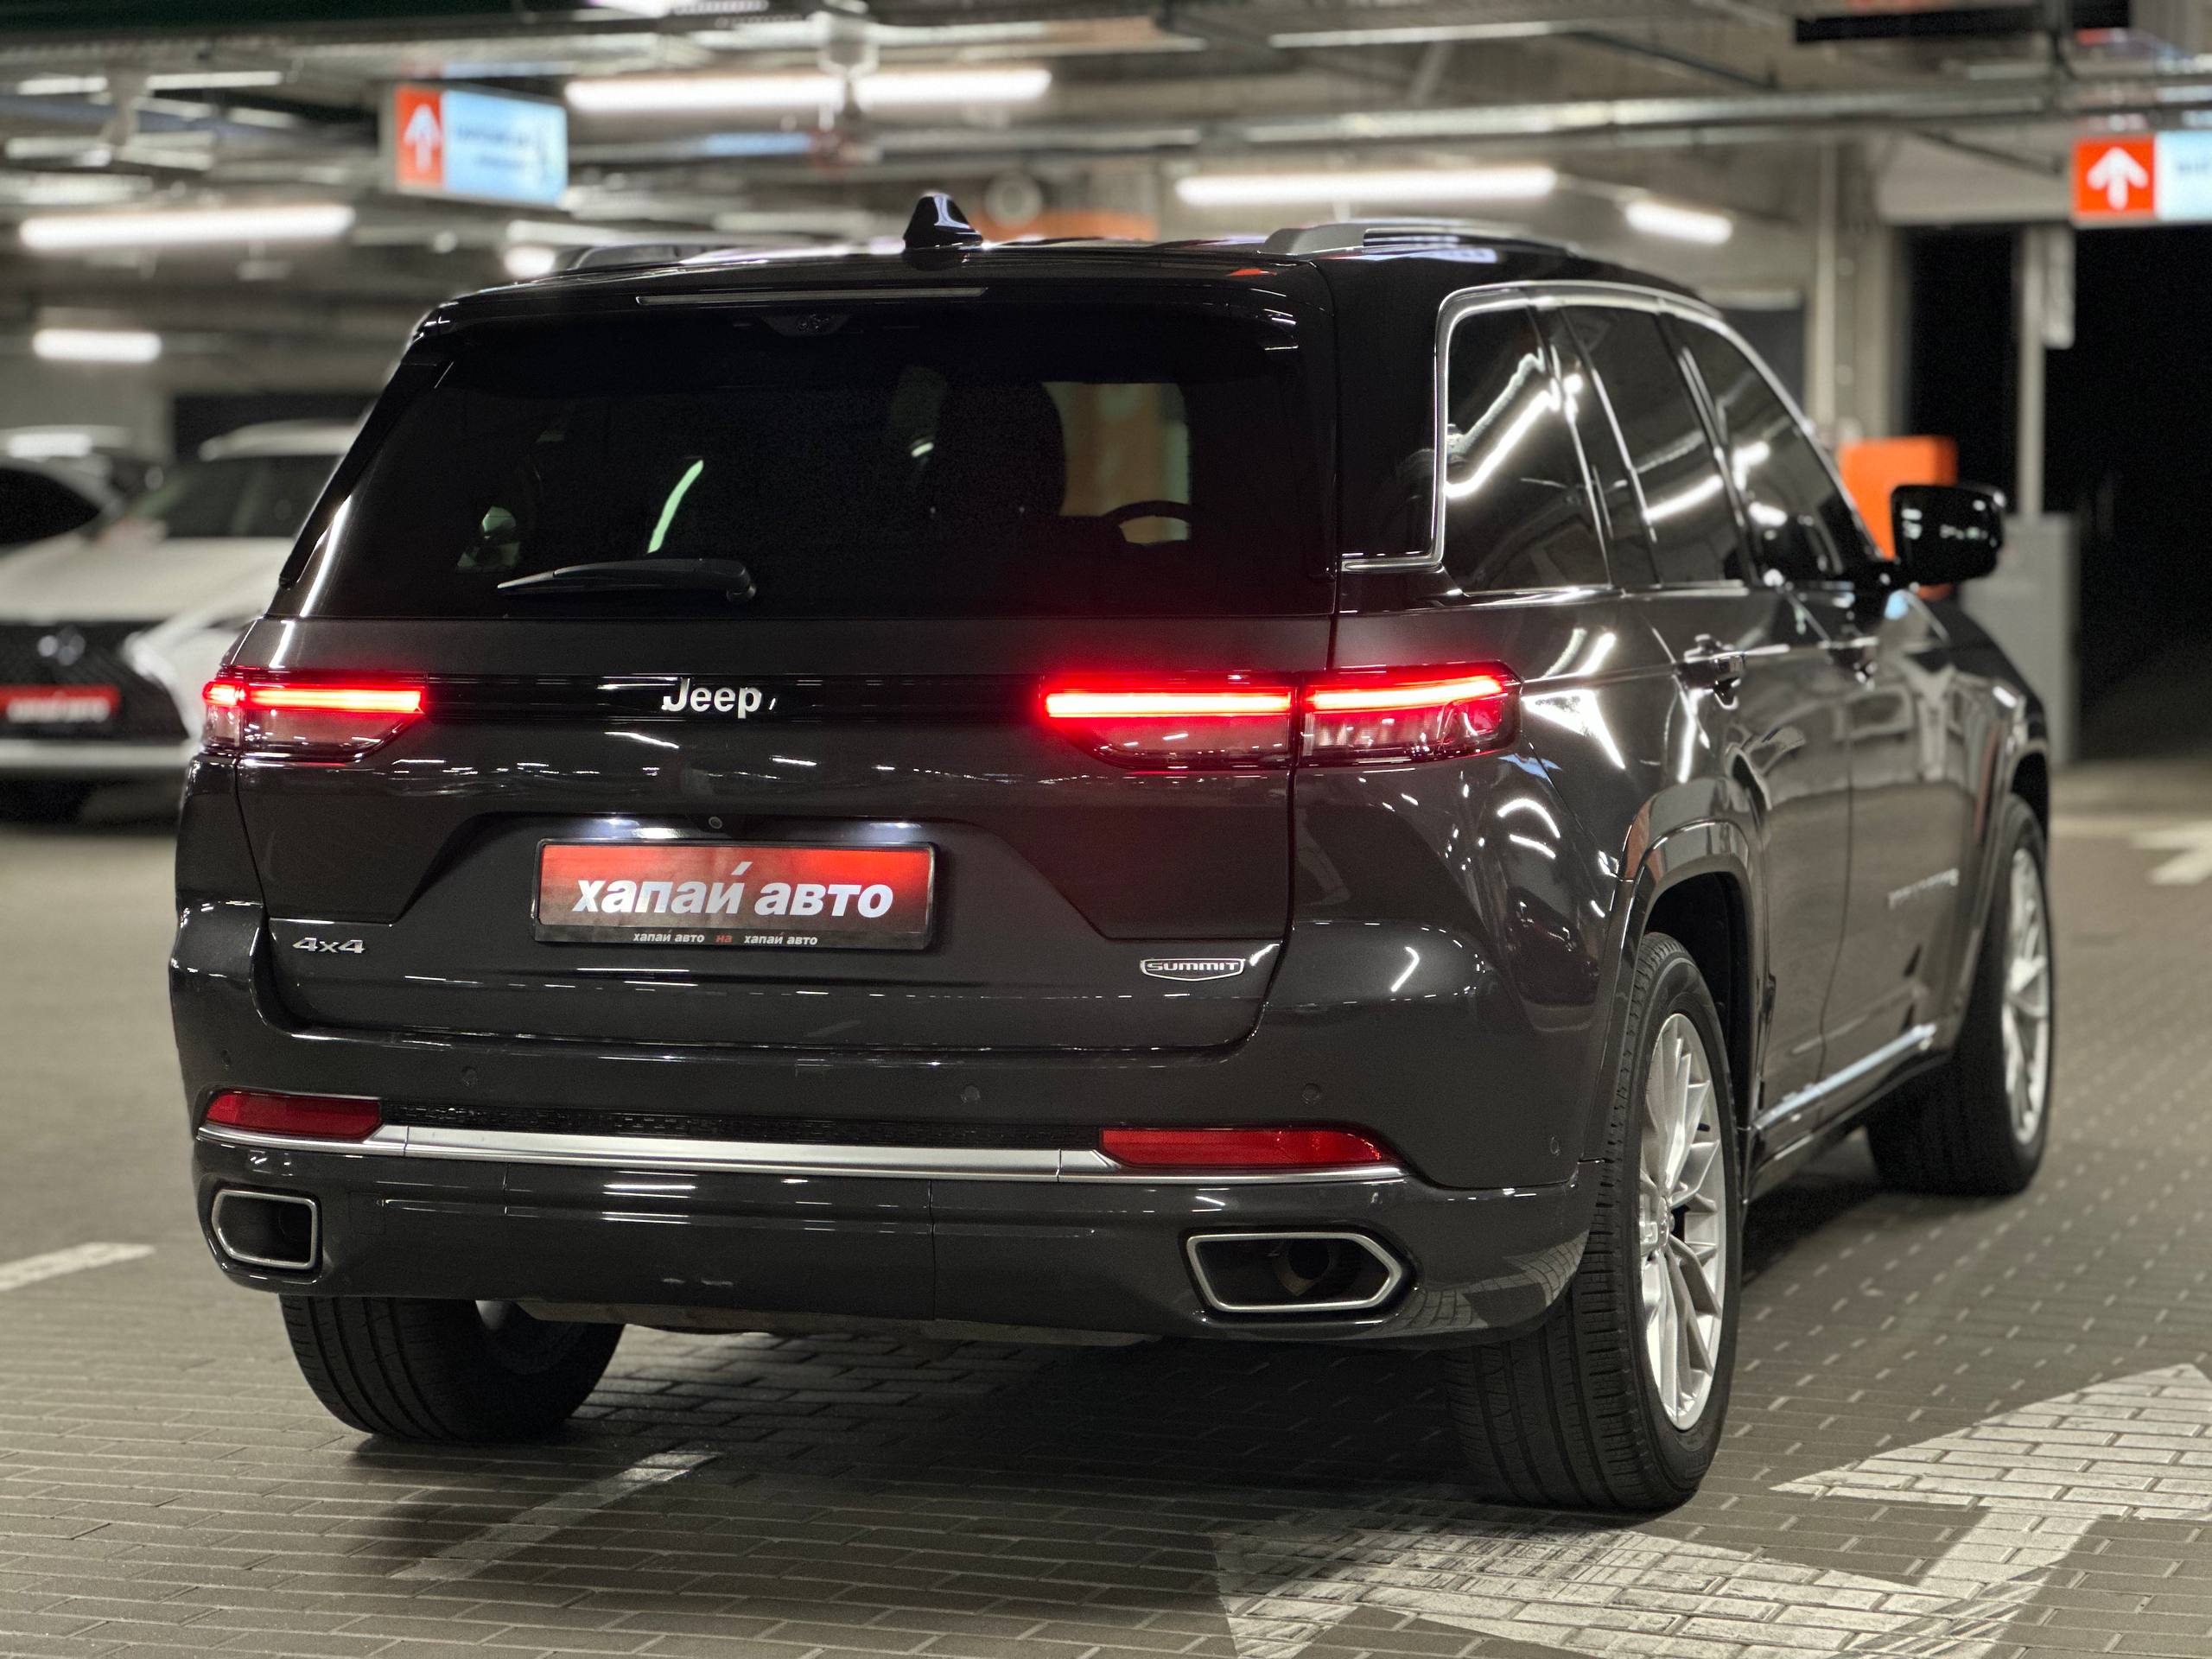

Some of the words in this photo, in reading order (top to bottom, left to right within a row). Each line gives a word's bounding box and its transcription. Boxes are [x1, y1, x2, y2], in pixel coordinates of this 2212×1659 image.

[660, 677, 762, 719] Jeep
[754, 881, 893, 918] авто
[293, 938, 365, 954] 4x4
[674, 932, 705, 944] авто
[715, 933, 733, 944] на
[786, 935, 817, 945] авто
[1147, 962, 1239, 971] SUMMIT
